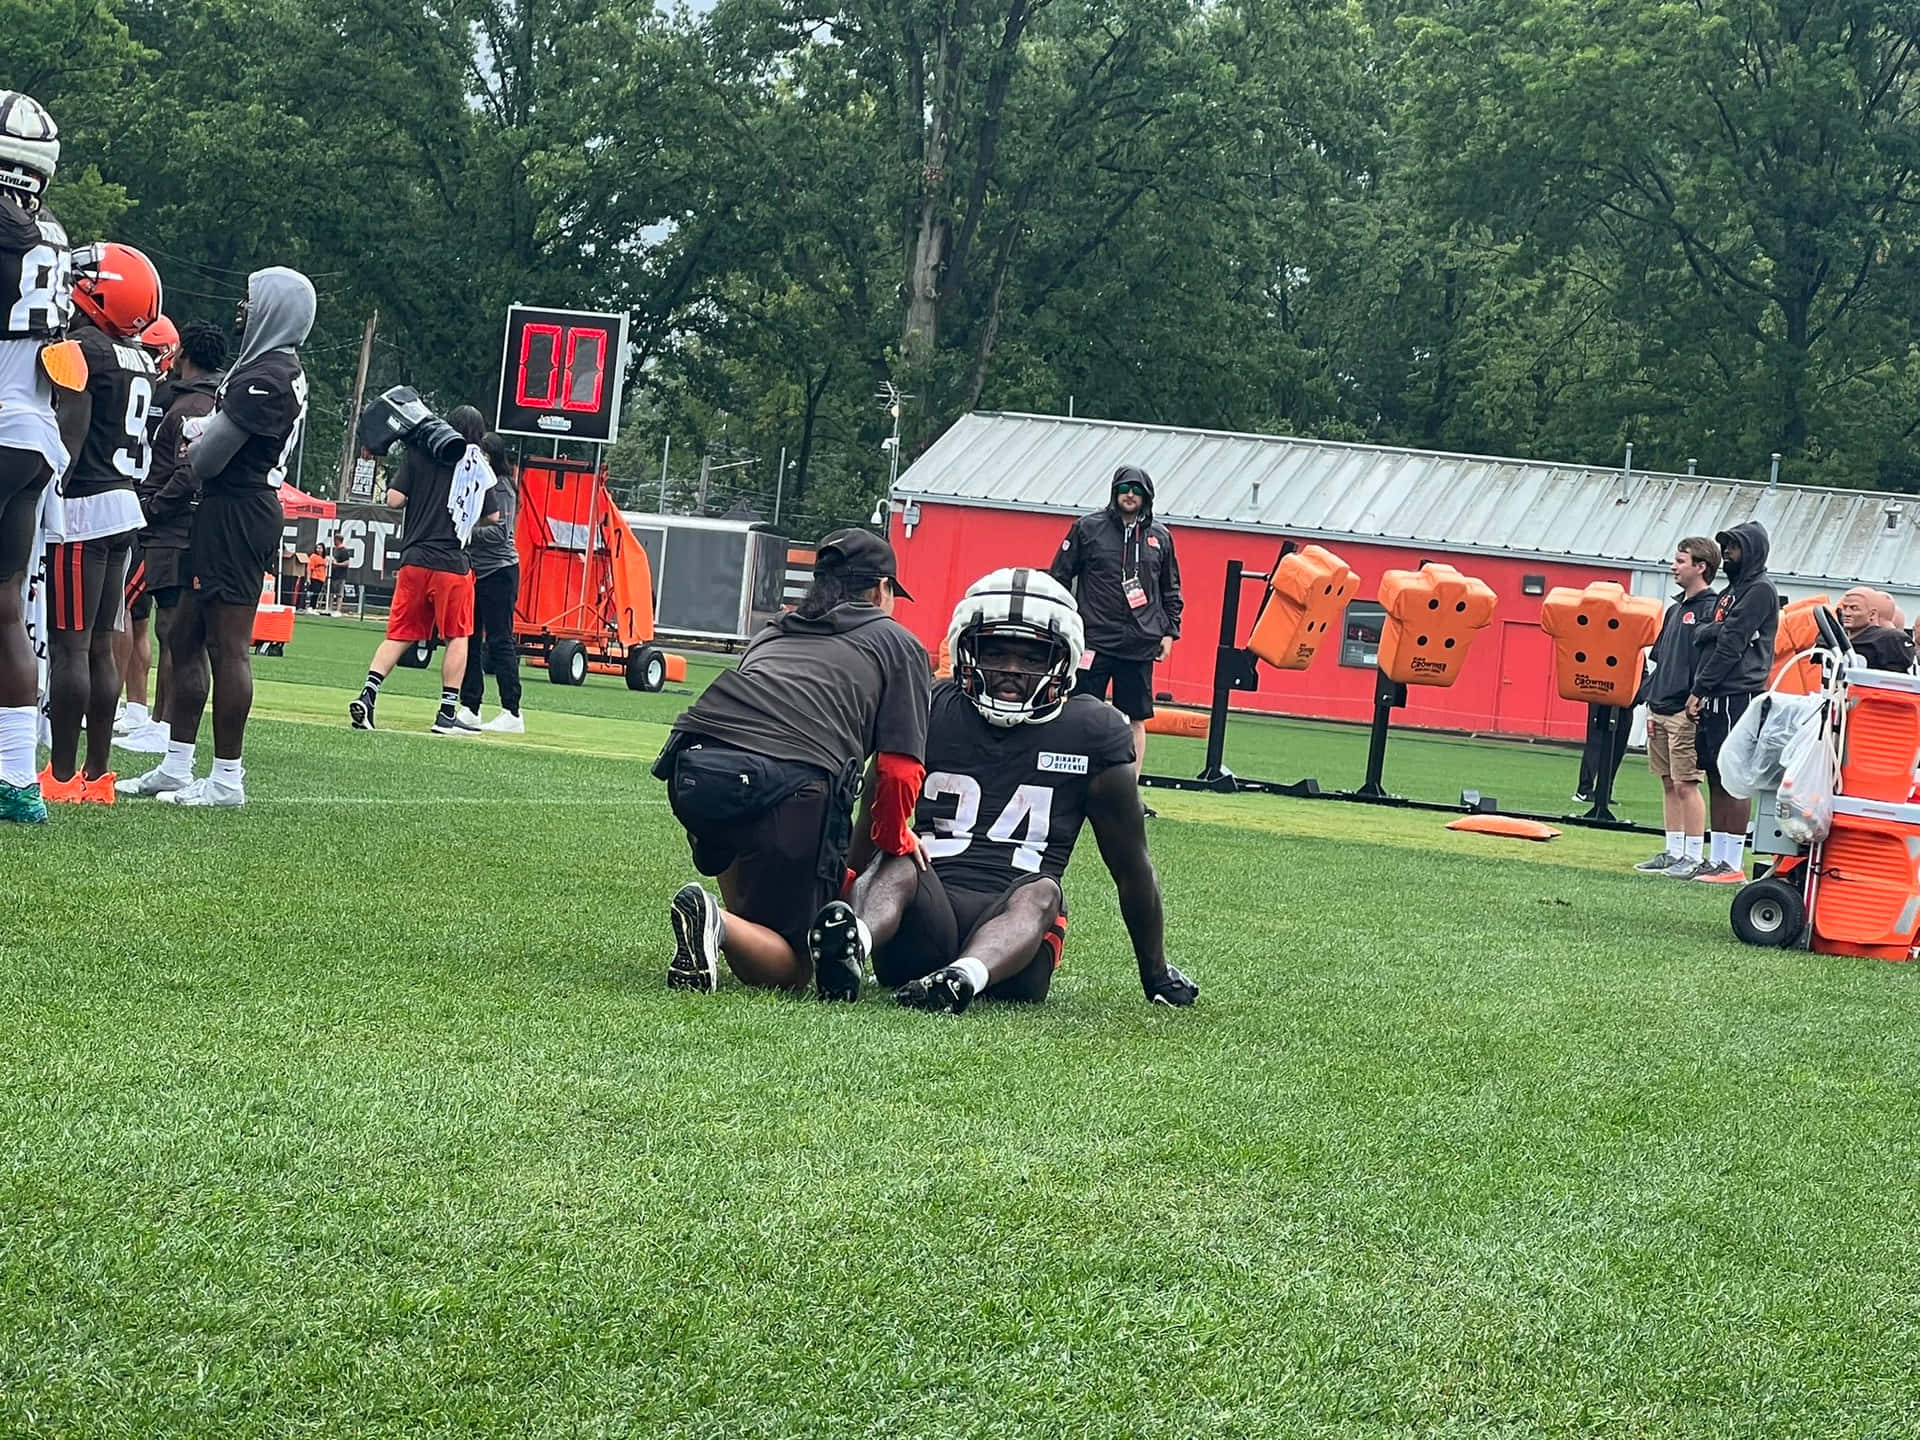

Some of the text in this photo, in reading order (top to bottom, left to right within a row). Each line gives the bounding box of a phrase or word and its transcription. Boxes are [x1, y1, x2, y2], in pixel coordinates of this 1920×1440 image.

[515, 322, 608, 413] 00
[112, 376, 152, 484] 9
[920, 771, 1053, 873] 34
